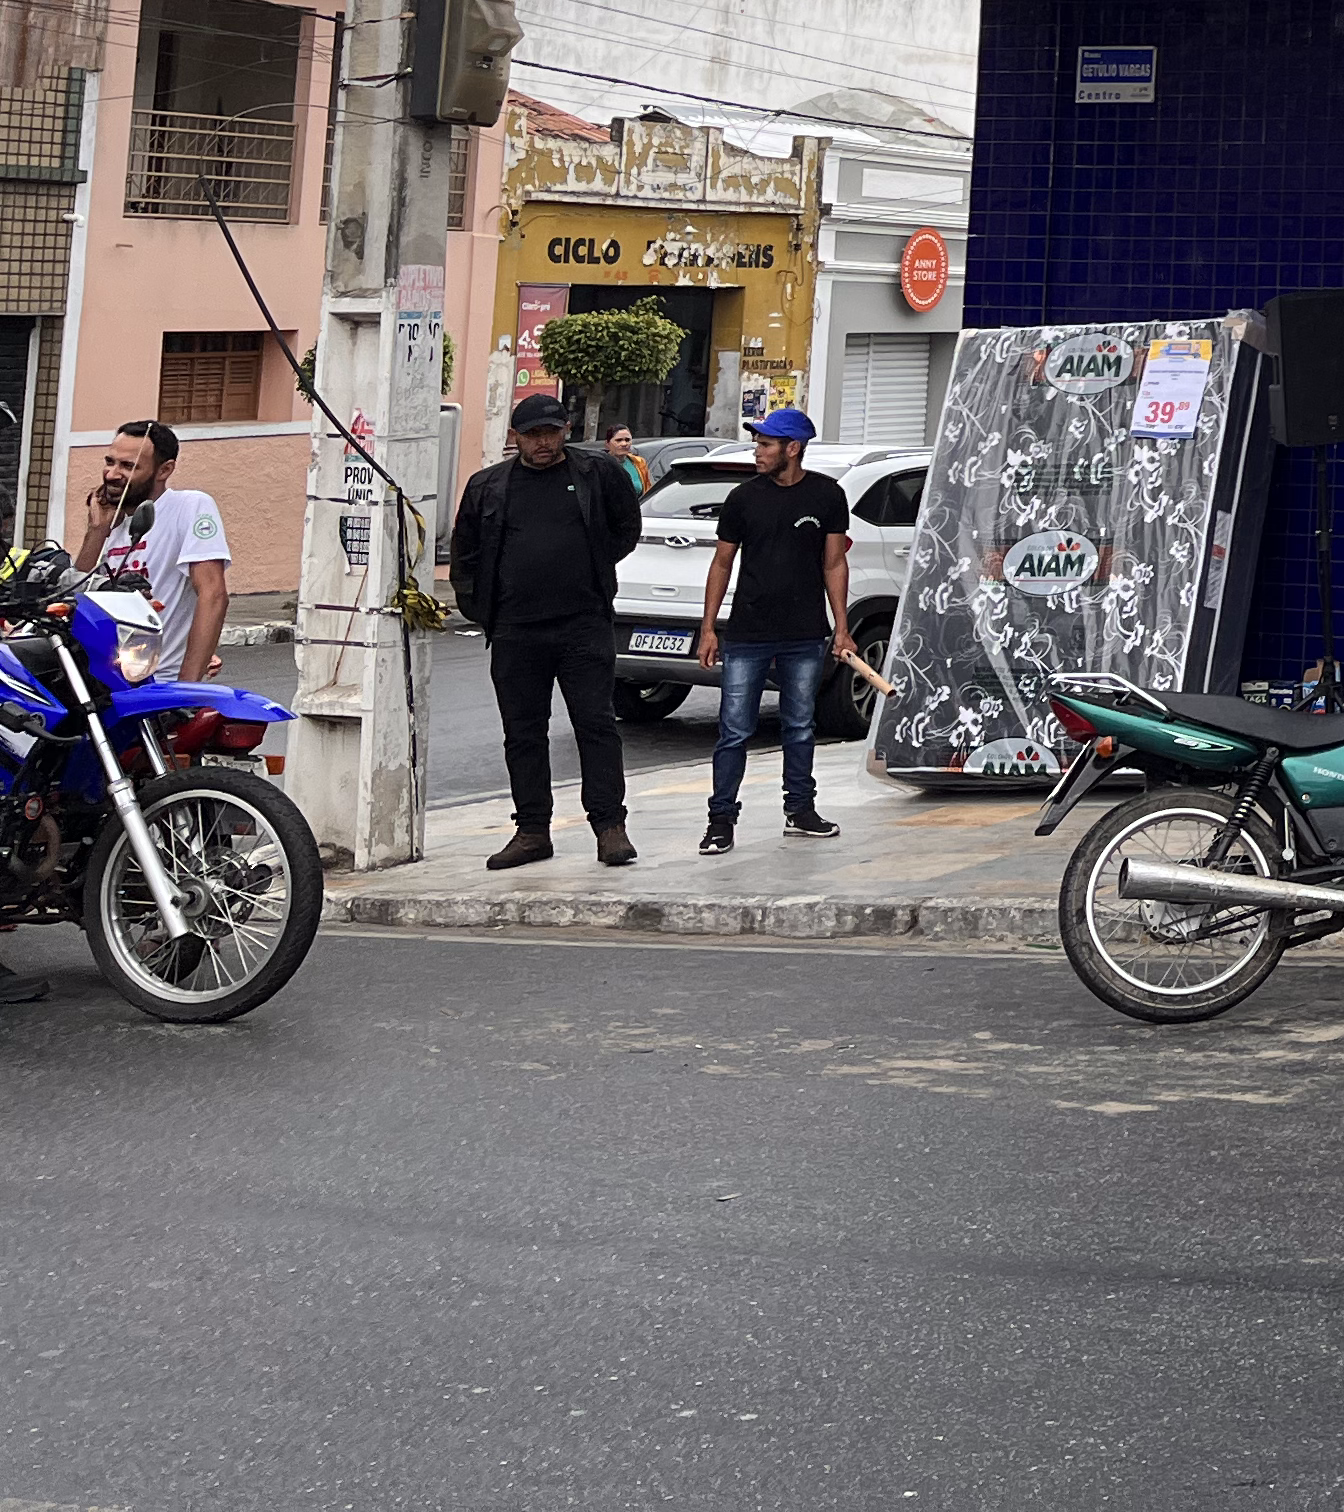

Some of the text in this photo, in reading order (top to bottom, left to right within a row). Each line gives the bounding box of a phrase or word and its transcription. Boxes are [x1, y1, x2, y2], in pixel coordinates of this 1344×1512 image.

[1079, 90, 1121, 100] Centro
[547, 237, 621, 264] CICLO
[914, 259, 937, 269] ANNY
[913, 270, 937, 281] STORE
[1055, 354, 1122, 379] AIAM
[1014, 552, 1087, 578] AIAM
